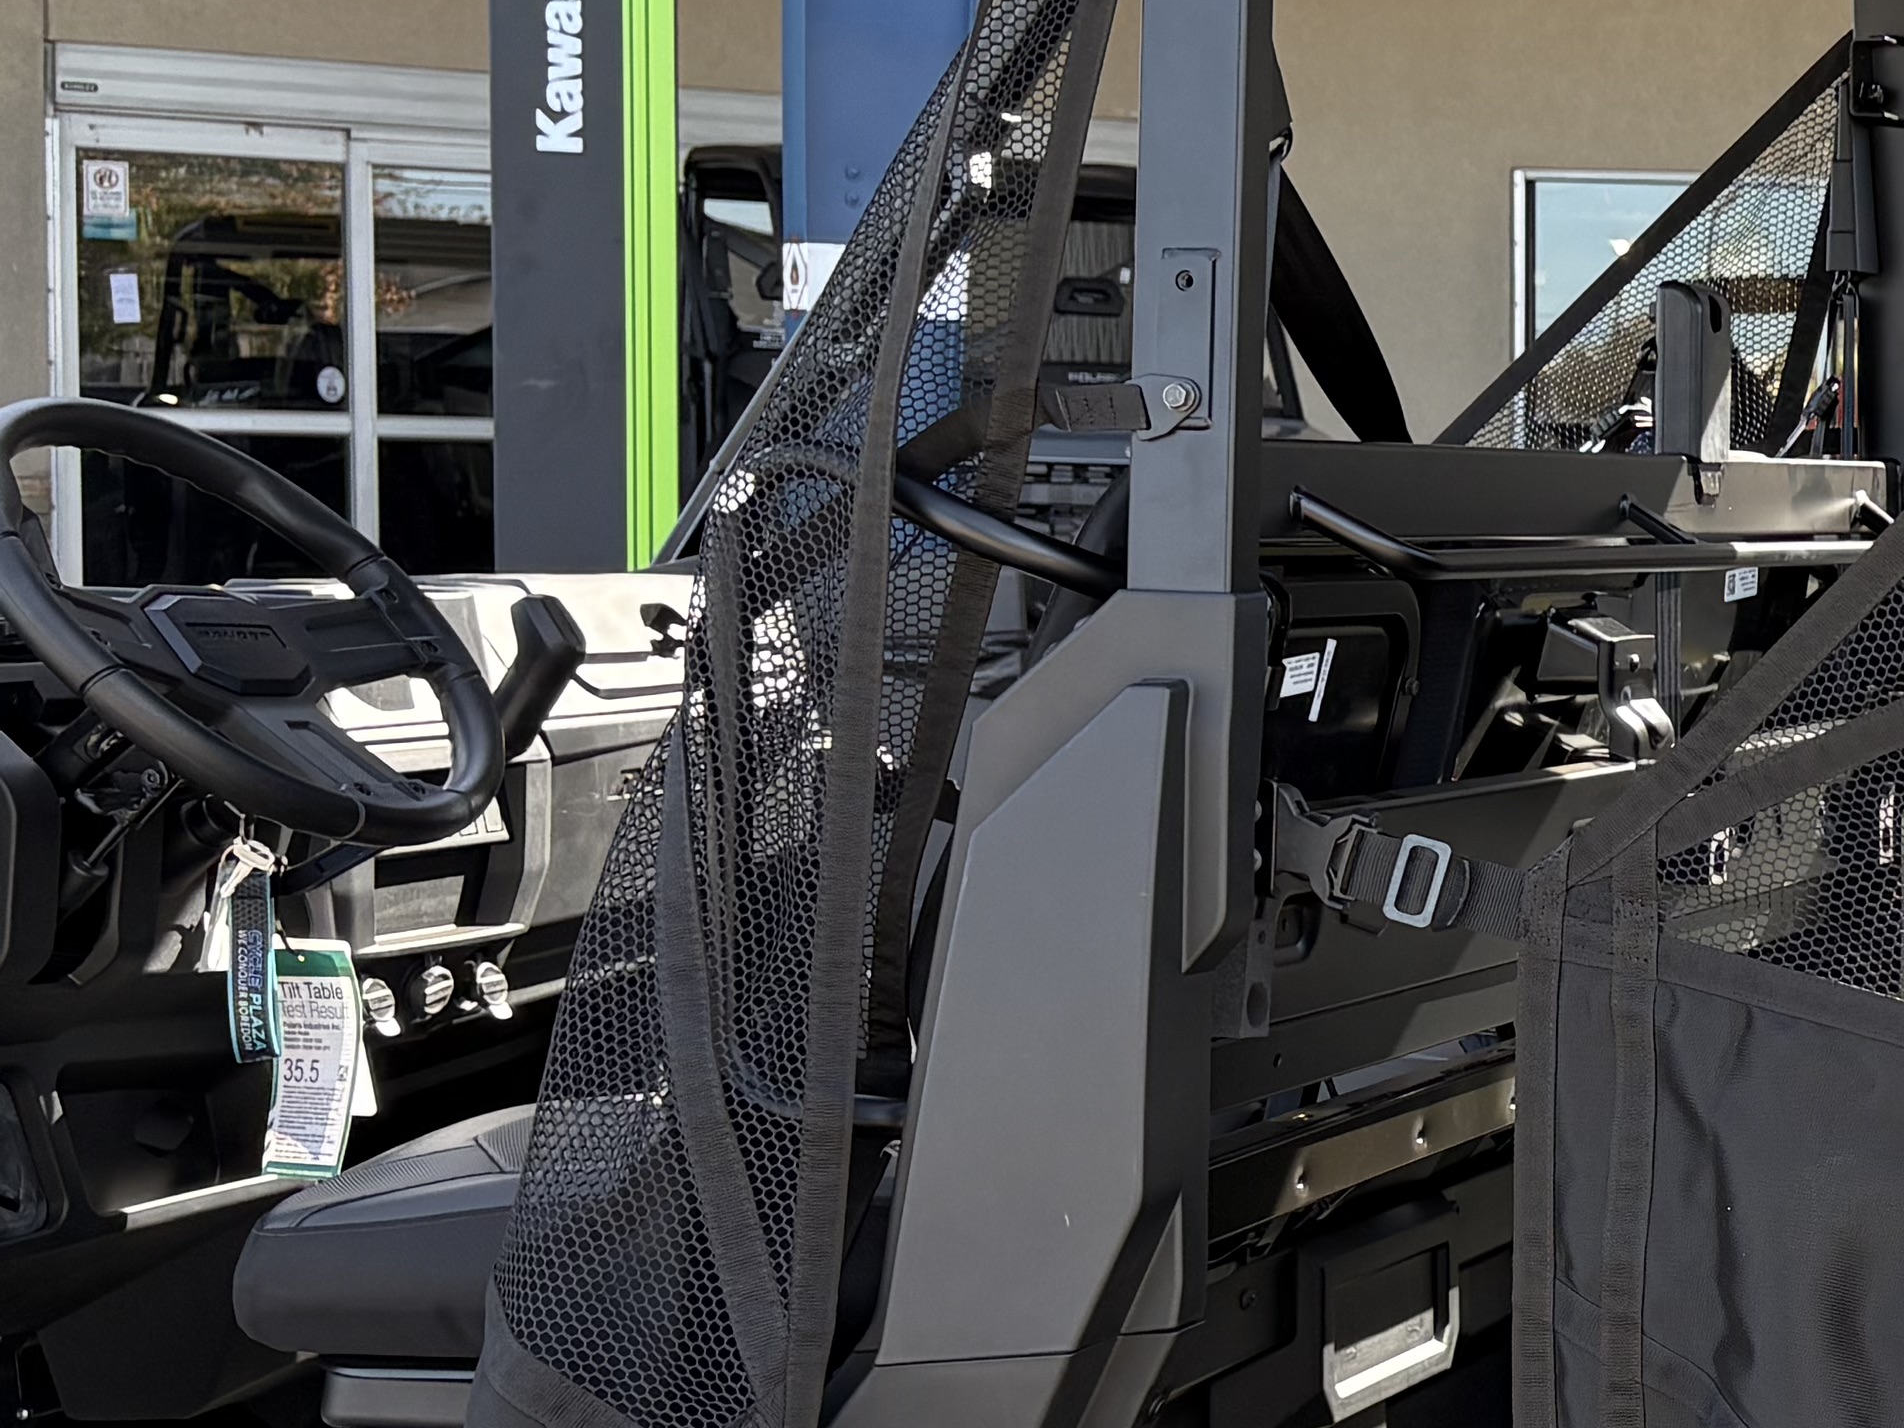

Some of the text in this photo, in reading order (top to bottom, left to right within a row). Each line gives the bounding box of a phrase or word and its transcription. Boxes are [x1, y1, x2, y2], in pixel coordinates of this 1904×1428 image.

[237, 948, 249, 999] CONQUER
[247, 929, 267, 1051] CYCLE PLAZA
[278, 980, 344, 1000] Tilt Table
[238, 1000, 254, 1051] BOREDOM
[278, 999, 307, 1018] Test
[283, 1057, 320, 1083] 35.5
